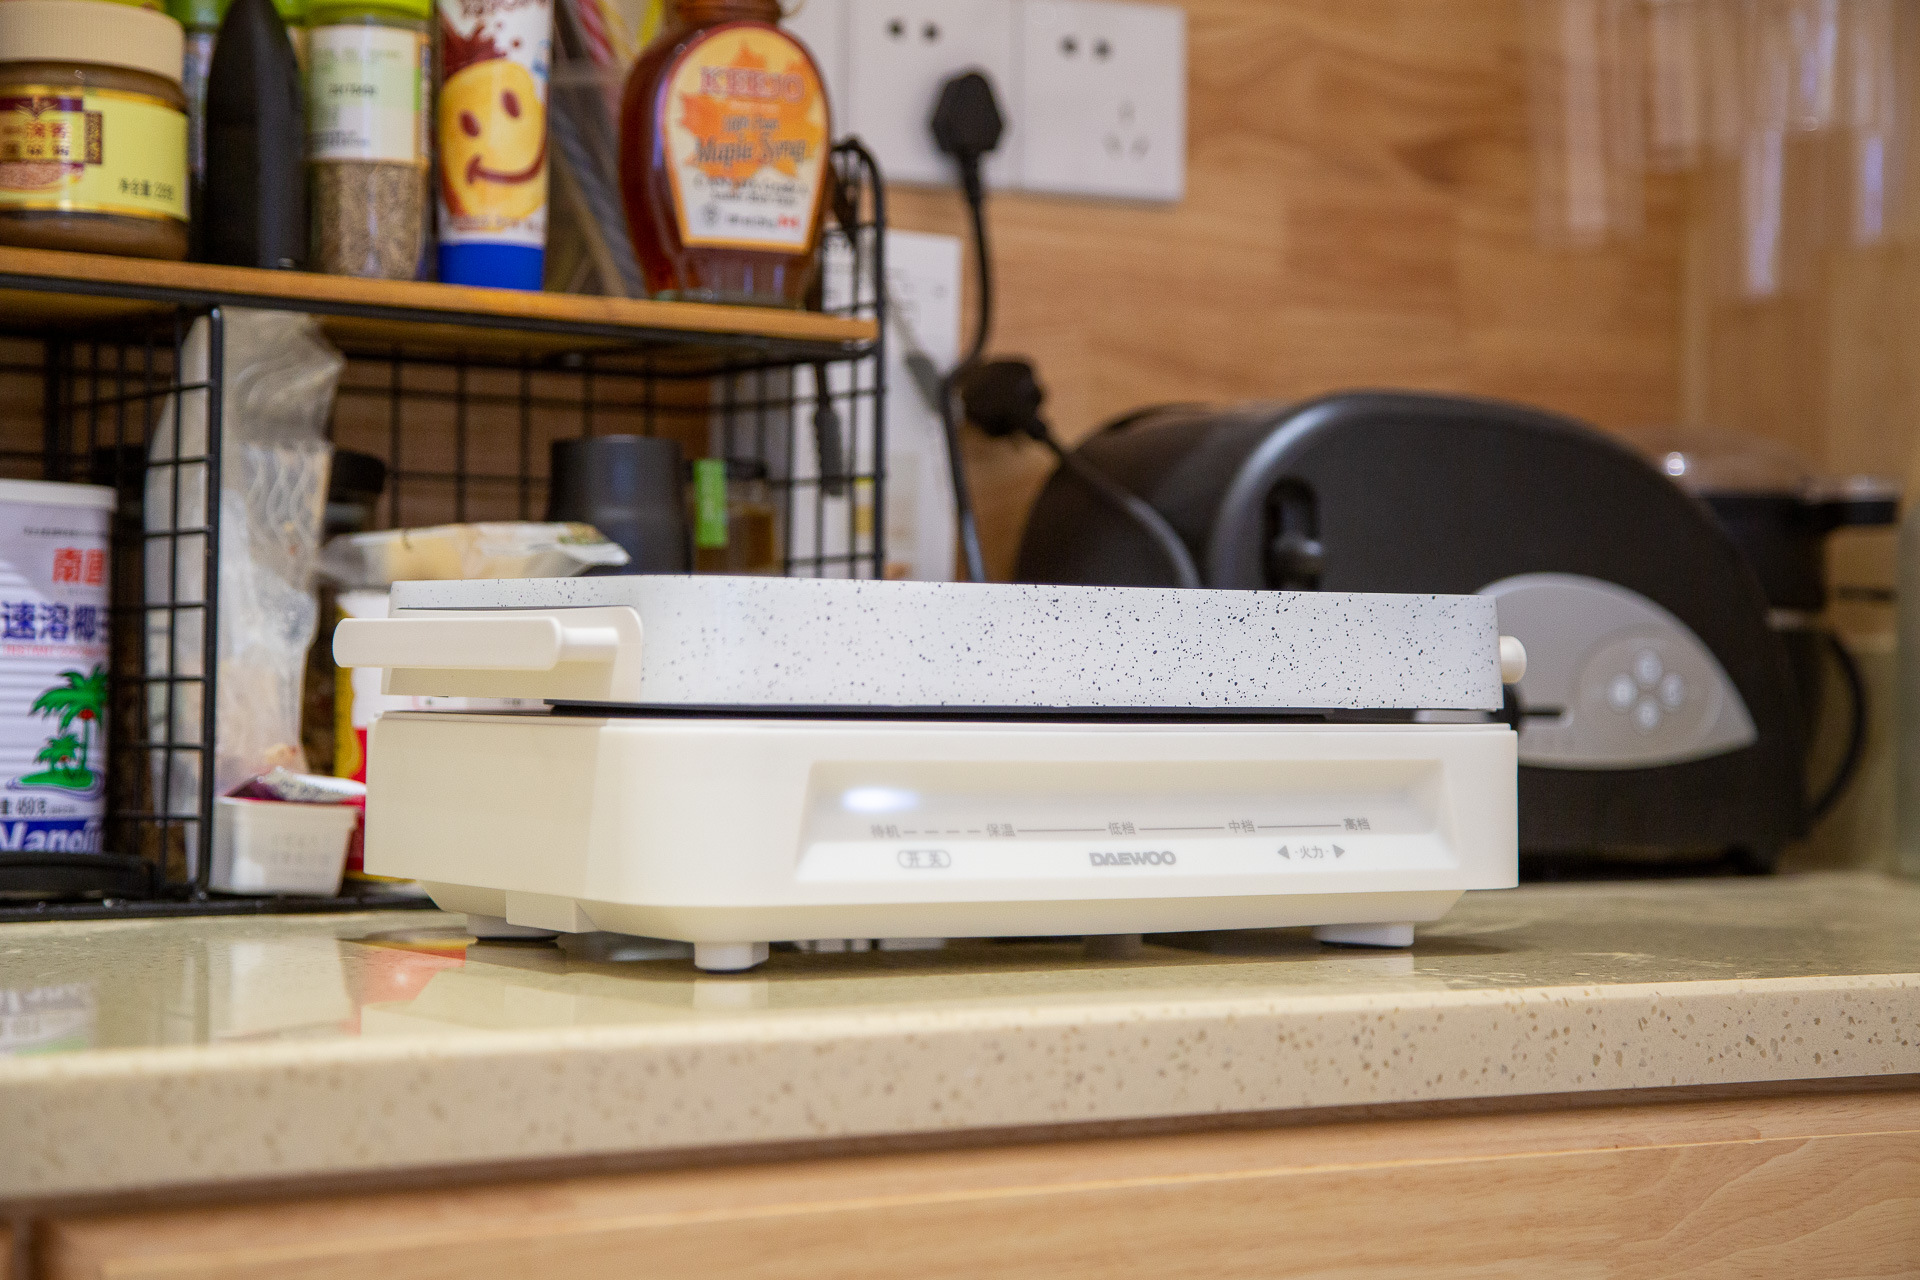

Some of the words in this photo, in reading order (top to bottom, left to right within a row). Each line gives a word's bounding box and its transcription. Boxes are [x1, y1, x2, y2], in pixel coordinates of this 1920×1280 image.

[986, 822, 1016, 838] 保温
[1108, 821, 1136, 836] 低档
[1229, 819, 1256, 833] 中档
[1344, 817, 1371, 831] 高档
[1088, 851, 1177, 867] DAEWOO
[1299, 845, 1325, 860] 火力
